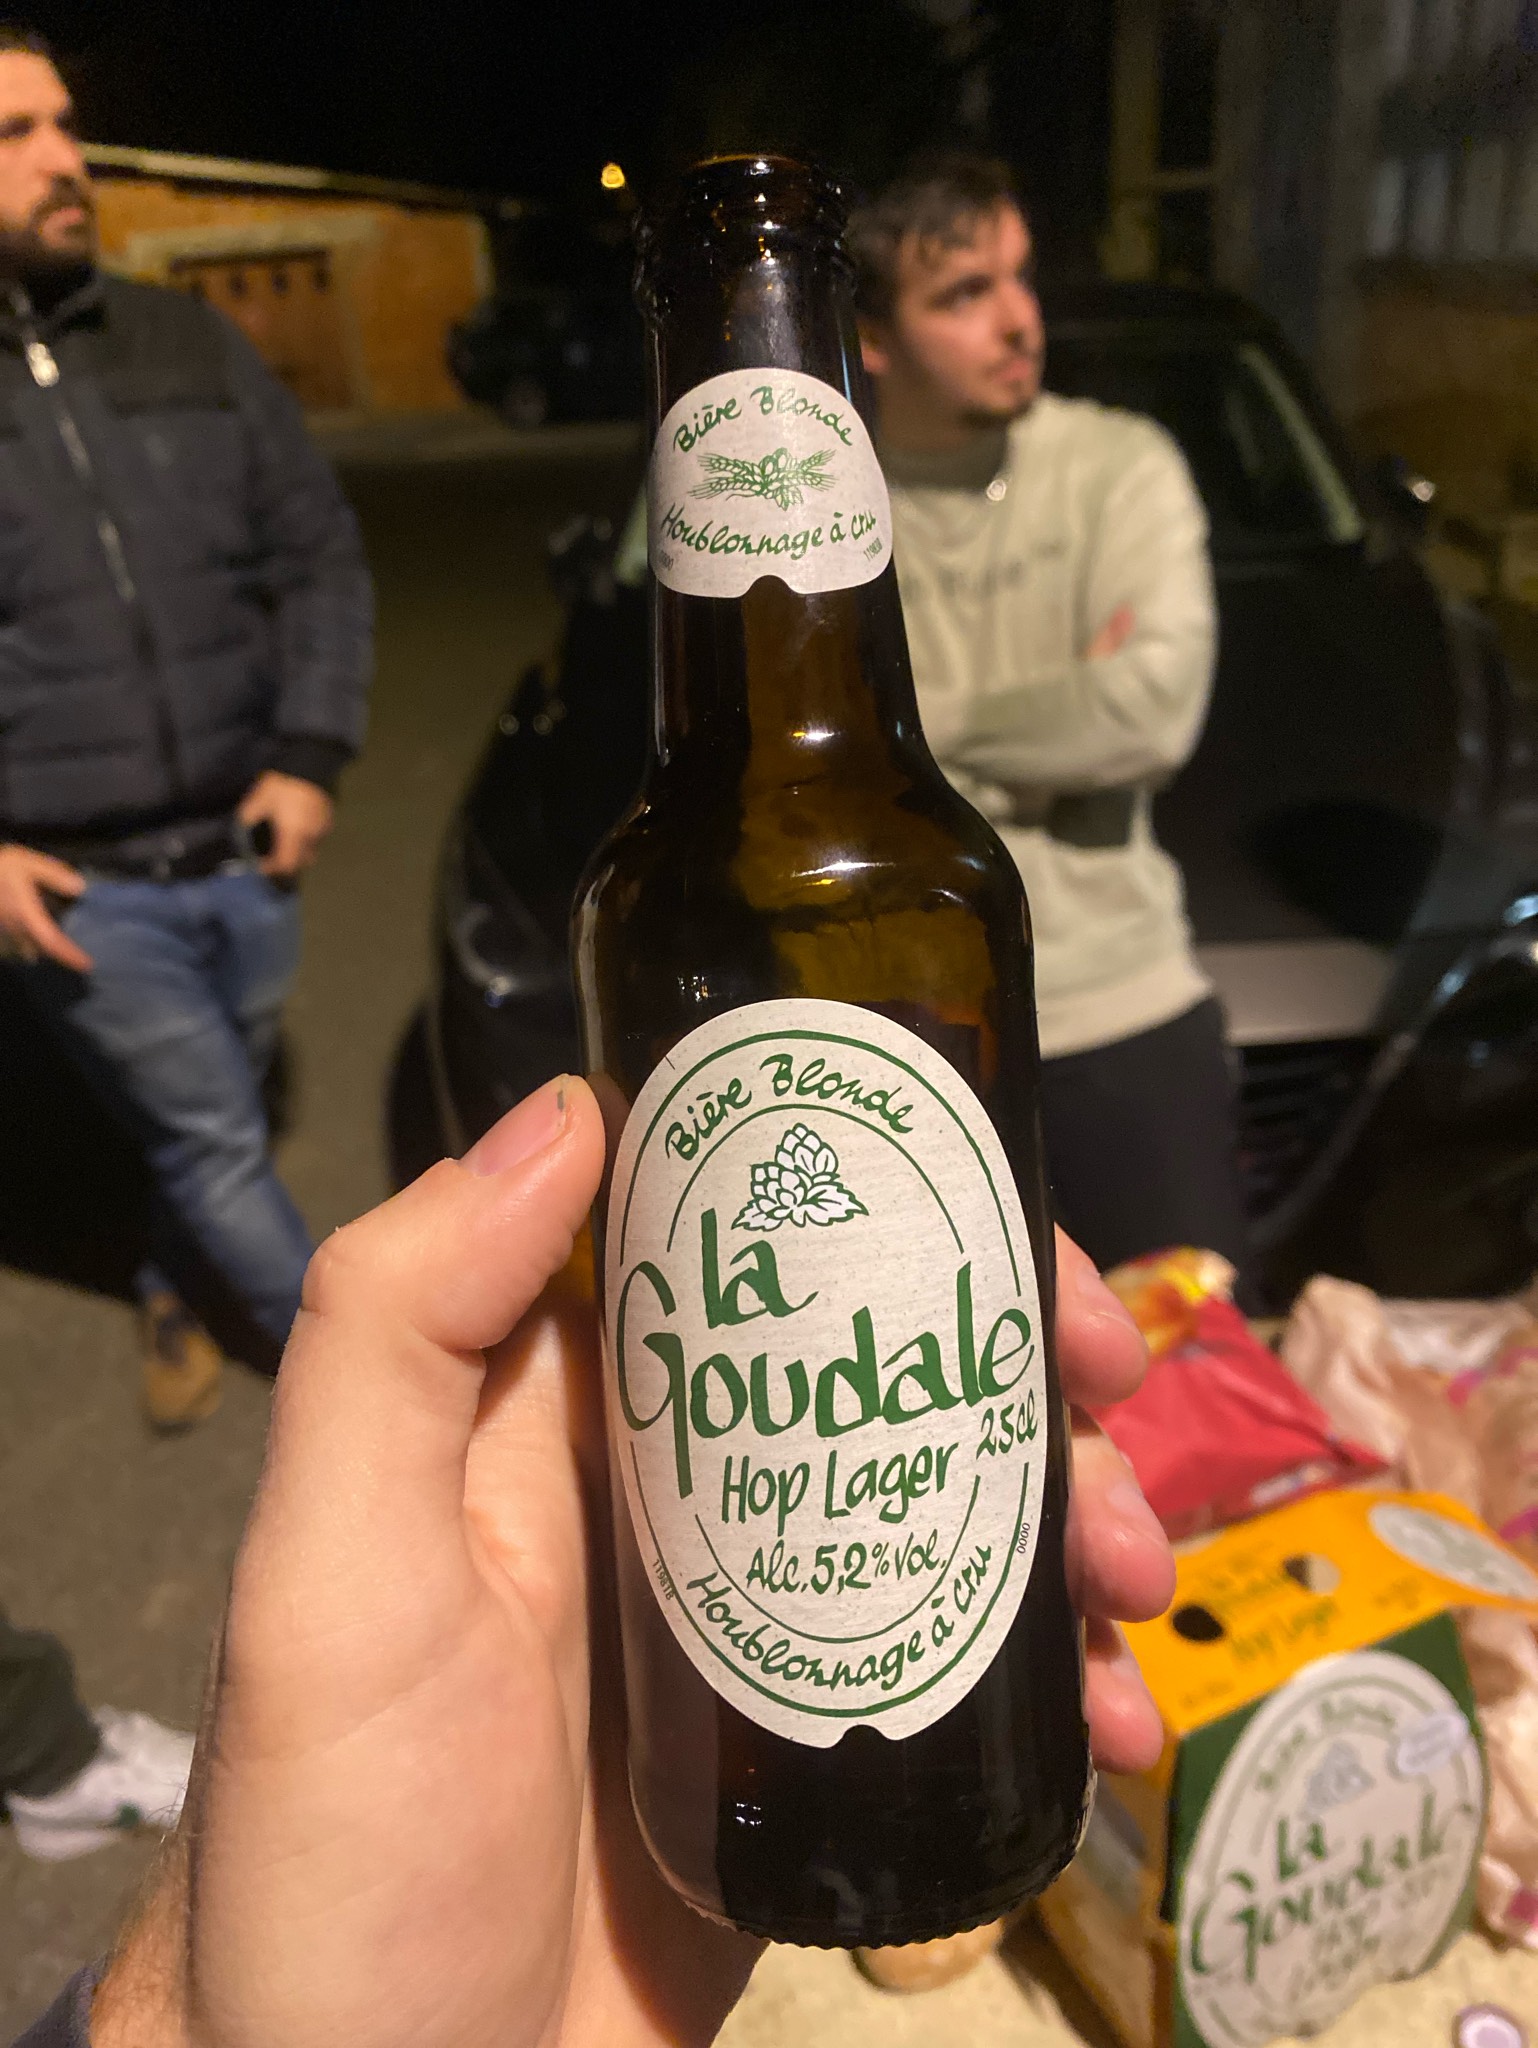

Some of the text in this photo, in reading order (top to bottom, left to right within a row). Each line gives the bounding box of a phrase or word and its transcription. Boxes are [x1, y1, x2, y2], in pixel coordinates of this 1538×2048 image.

[750, 385, 853, 446] Blonde
[661, 502, 823, 560] Houblonnage
[851, 509, 876, 540] cru
[759, 1053, 914, 1134] Blonde
[616, 1261, 1035, 1499] Goudale
[976, 1388, 1039, 1460] 25cl
[721, 1442, 959, 1537] Hop Lager
[1016, 1522, 1031, 1554] 0000
[686, 1572, 921, 1690] Houblonnage
[953, 1544, 992, 1613] cru
